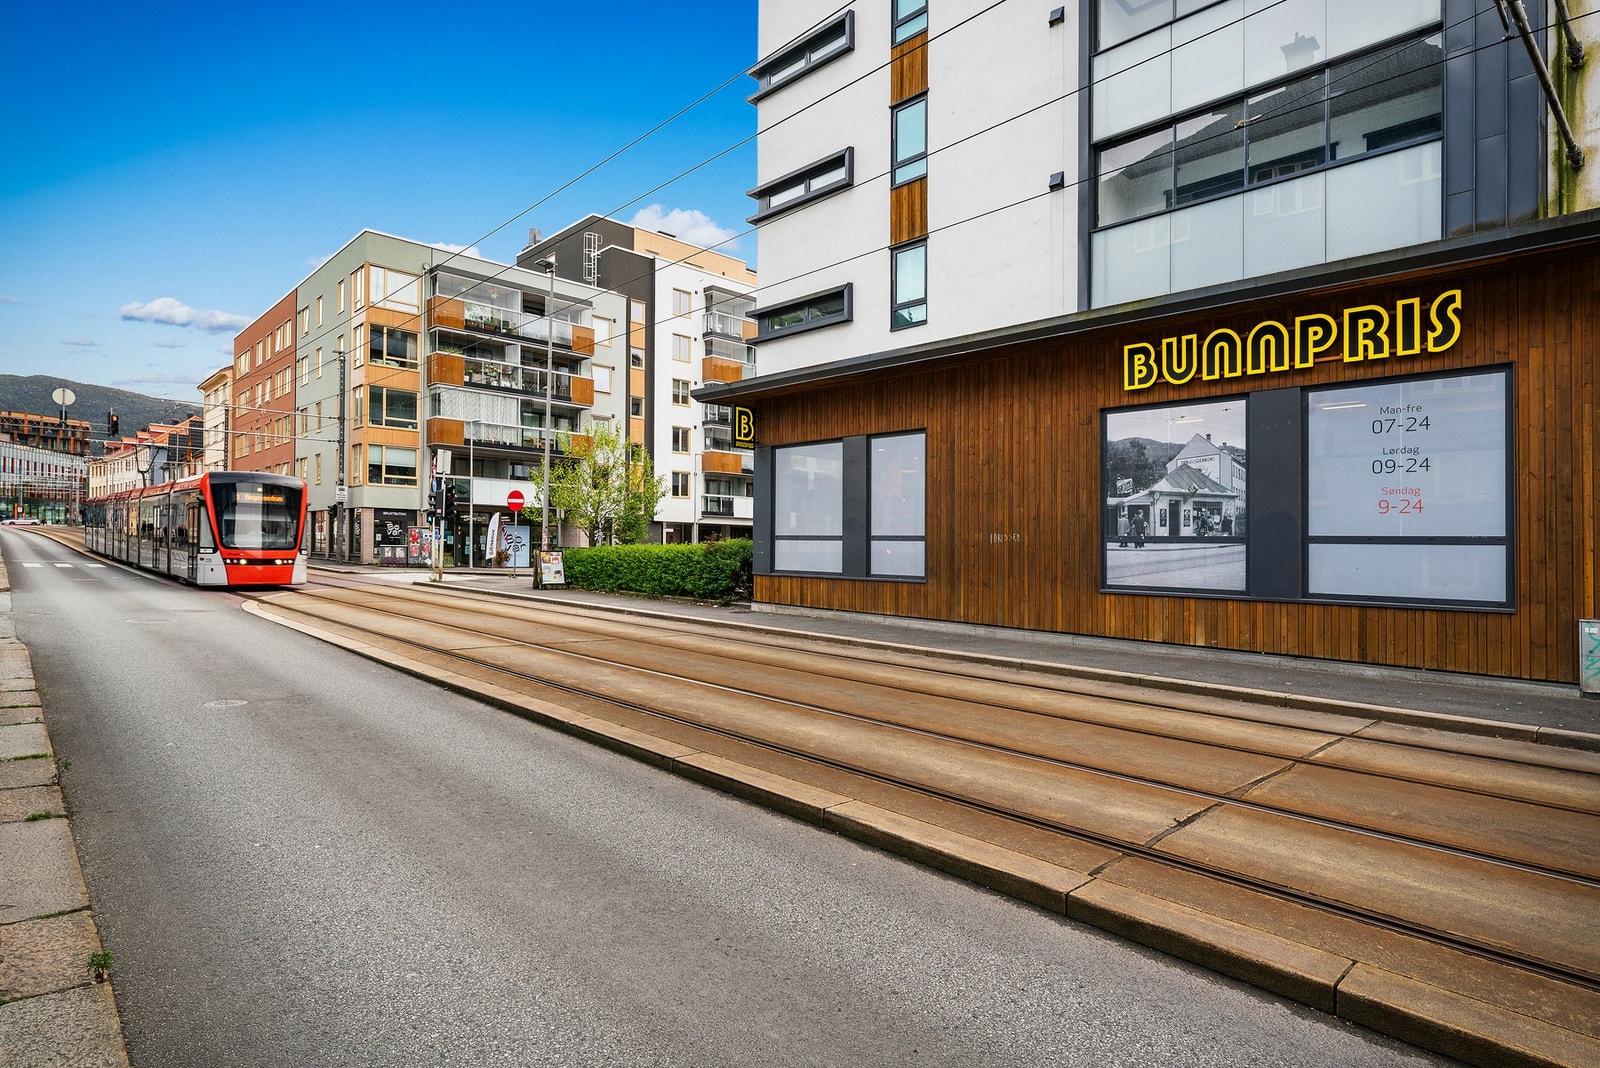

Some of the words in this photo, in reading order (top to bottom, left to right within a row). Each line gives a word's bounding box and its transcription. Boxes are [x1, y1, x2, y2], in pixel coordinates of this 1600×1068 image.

[1123, 289, 1462, 391] BUNNPRIS
[1379, 404, 1422, 415] Man-fre
[1372, 416, 1431, 434] 07-24
[1382, 446, 1420, 455] Lørdag
[1372, 457, 1431, 474] 09-24
[1381, 486, 1421, 497] Søndag
[1378, 499, 1424, 515] 9-24
